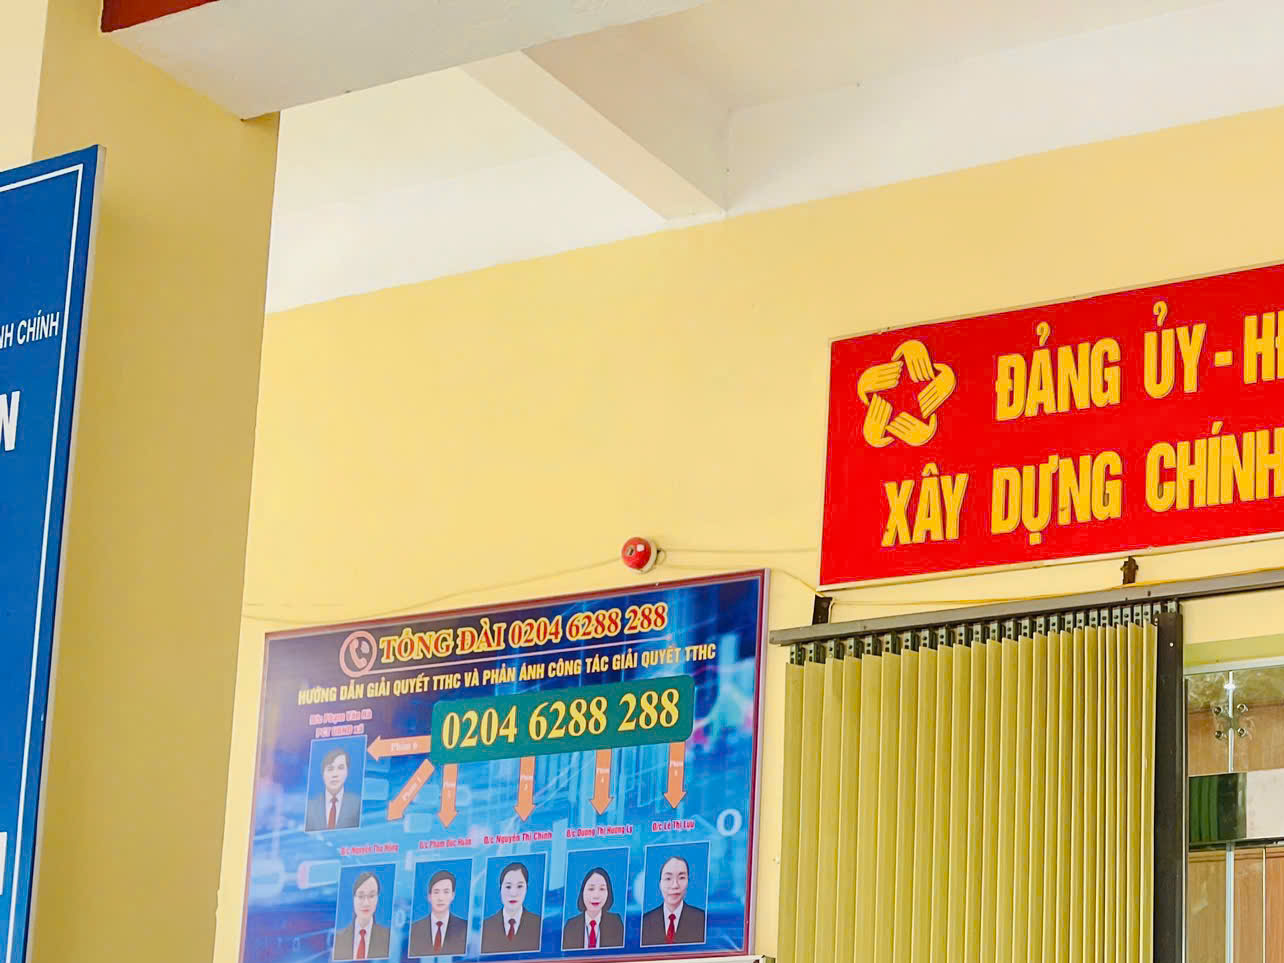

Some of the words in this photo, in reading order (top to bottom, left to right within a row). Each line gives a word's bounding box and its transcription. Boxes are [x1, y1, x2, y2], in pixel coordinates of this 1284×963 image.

[17, 309, 60, 345] CHÍNH
[996, 321, 1121, 420] ĐẢNG
[1144, 301, 1207, 398] ỦY
[881, 463, 968, 547] XÂY
[991, 450, 1122, 545] DỰNG
[456, 617, 506, 655] ĐÀI
[508, 614, 563, 648] 0204
[566, 606, 622, 641] 6288
[624, 601, 669, 635] 288
[367, 676, 391, 698] GIẢI
[394, 672, 430, 697] QUYẾT
[432, 674, 461, 692] TTHC
[464, 668, 480, 687] VÀ
[482, 663, 516, 686] PHẢN
[519, 661, 545, 682] ÁNH
[547, 658, 582, 678] CÔNG
[585, 653, 609, 674] TÁC
[612, 648, 638, 670] GIẢI
[641, 643, 681, 668] QUYẾT
[685, 643, 717, 662] TTHC
[442, 705, 518, 749] 0204
[528, 696, 608, 742] 6288
[617, 688, 680, 732] 288
